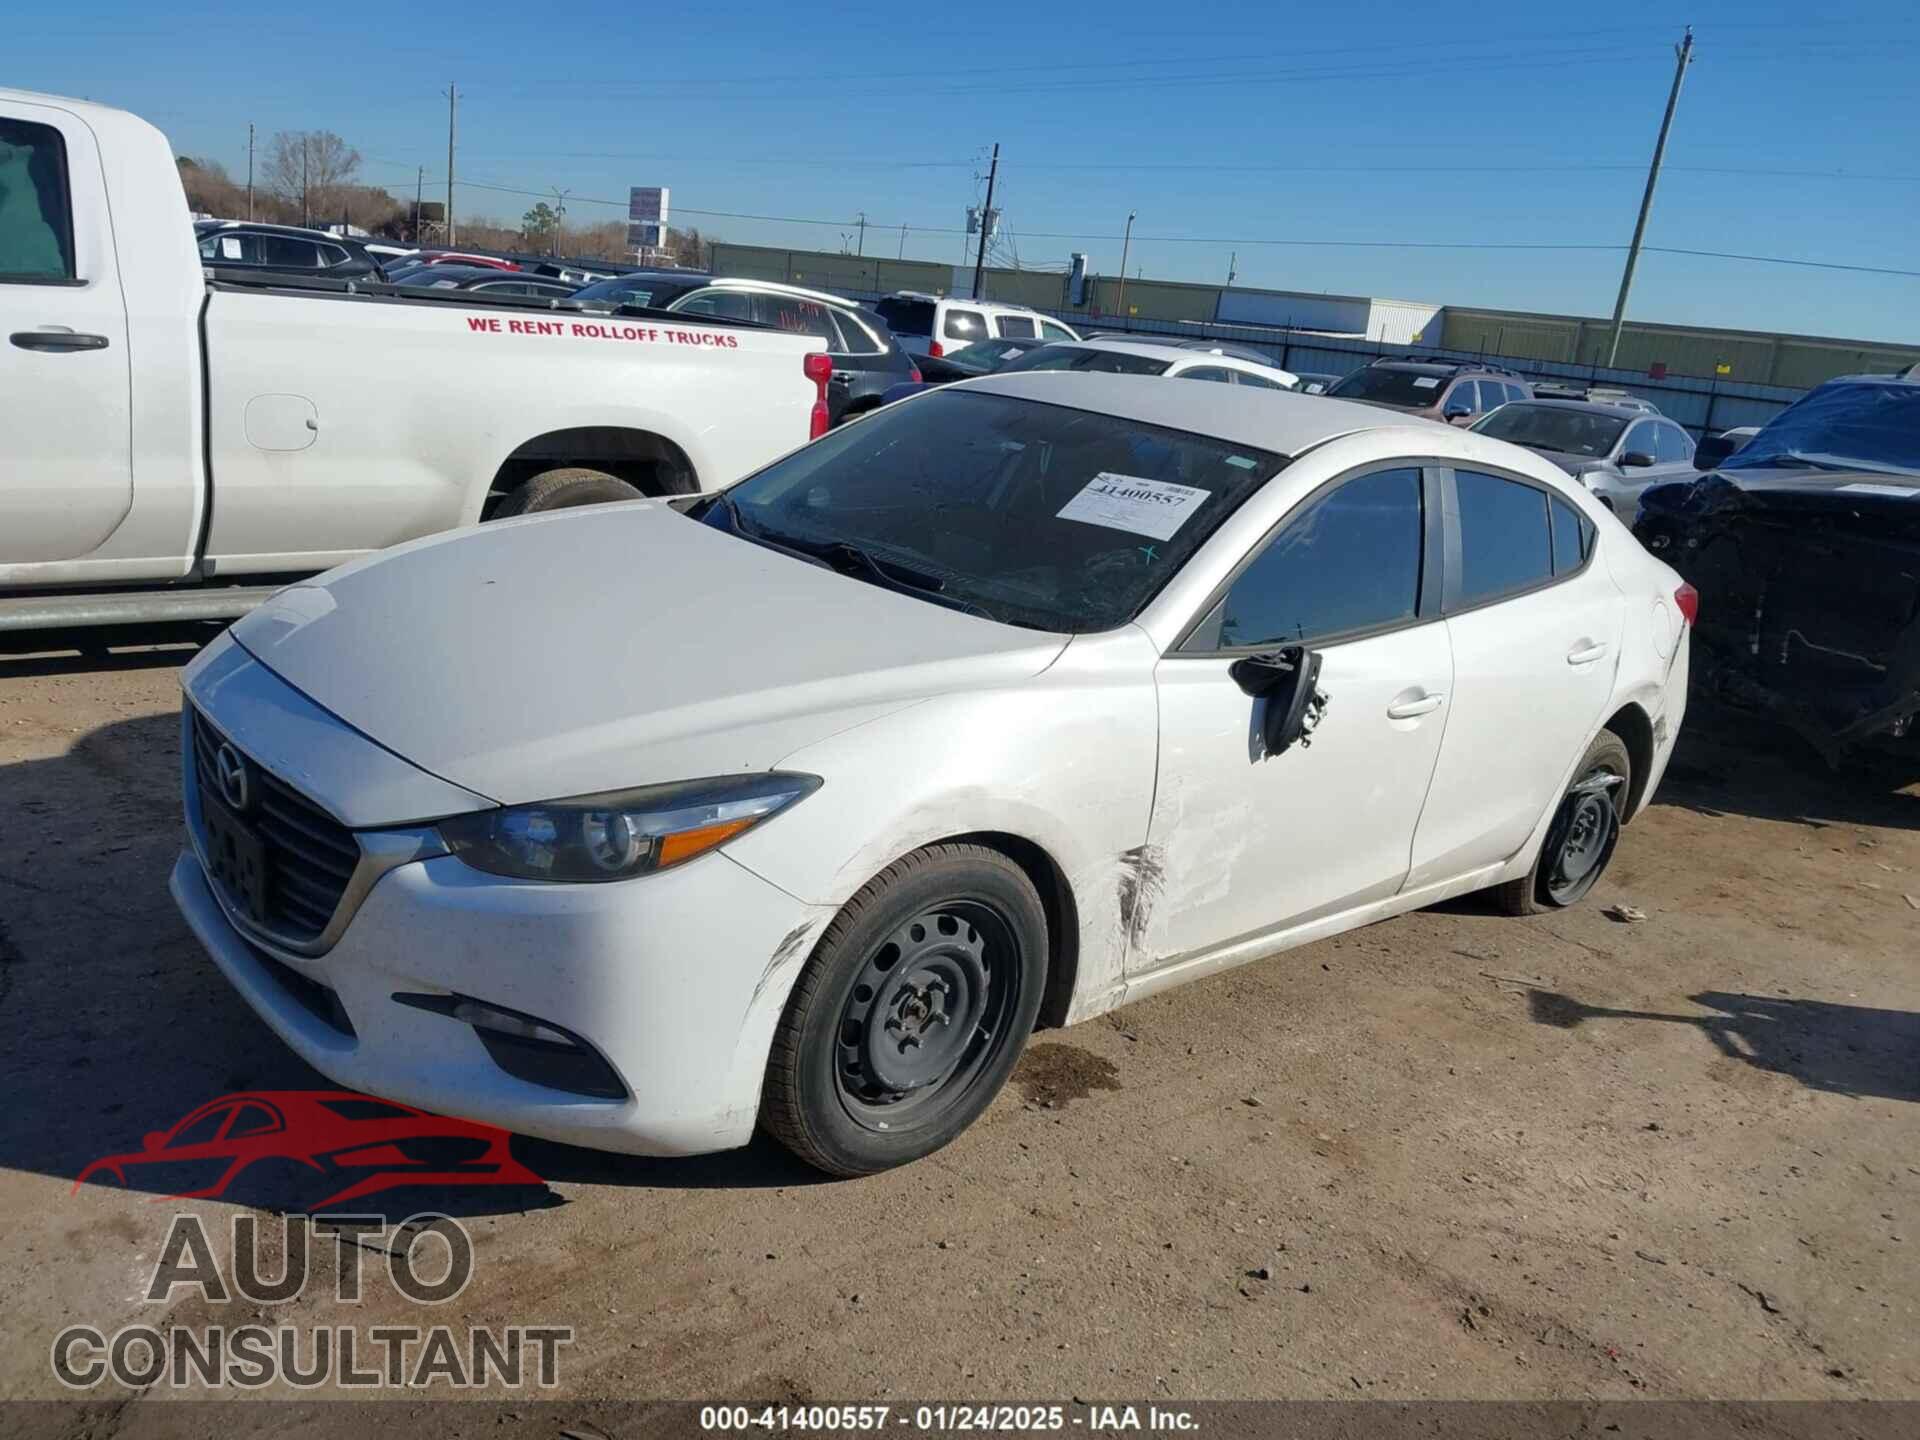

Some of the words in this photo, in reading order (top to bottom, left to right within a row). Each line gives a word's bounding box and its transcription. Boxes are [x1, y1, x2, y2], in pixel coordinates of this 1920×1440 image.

[467, 317, 501, 332] WE
[509, 320, 564, 336] RENT
[572, 324, 658, 341] ROLLOFF
[665, 330, 738, 348] TRUCKS
